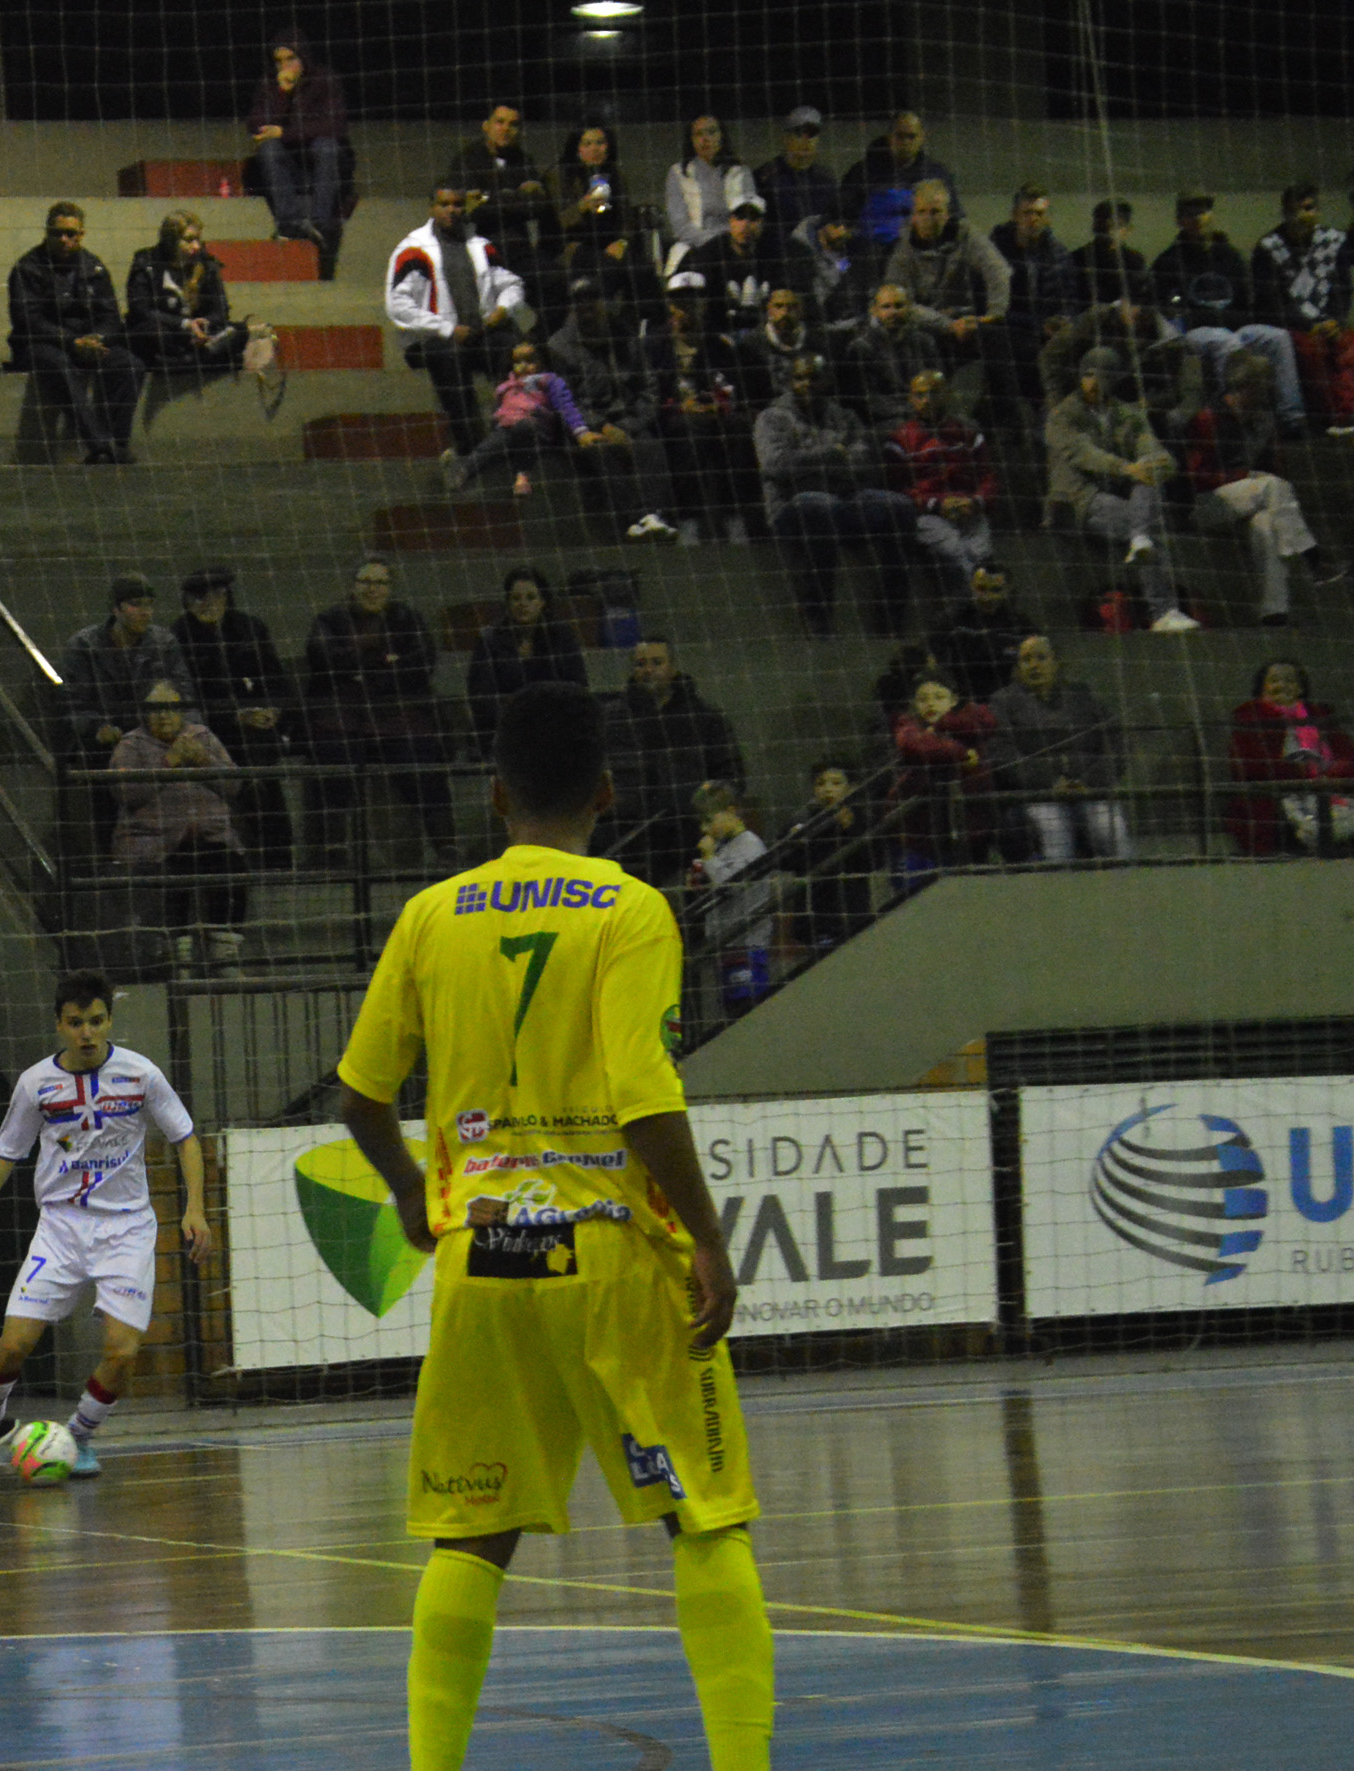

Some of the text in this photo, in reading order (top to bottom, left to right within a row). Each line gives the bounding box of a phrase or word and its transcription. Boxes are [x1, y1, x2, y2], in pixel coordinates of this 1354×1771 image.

[490, 876, 621, 913] UNISC
[500, 931, 560, 1087] 7
[1290, 1125, 1353, 1223] U
[26, 1256, 46, 1283] 7
